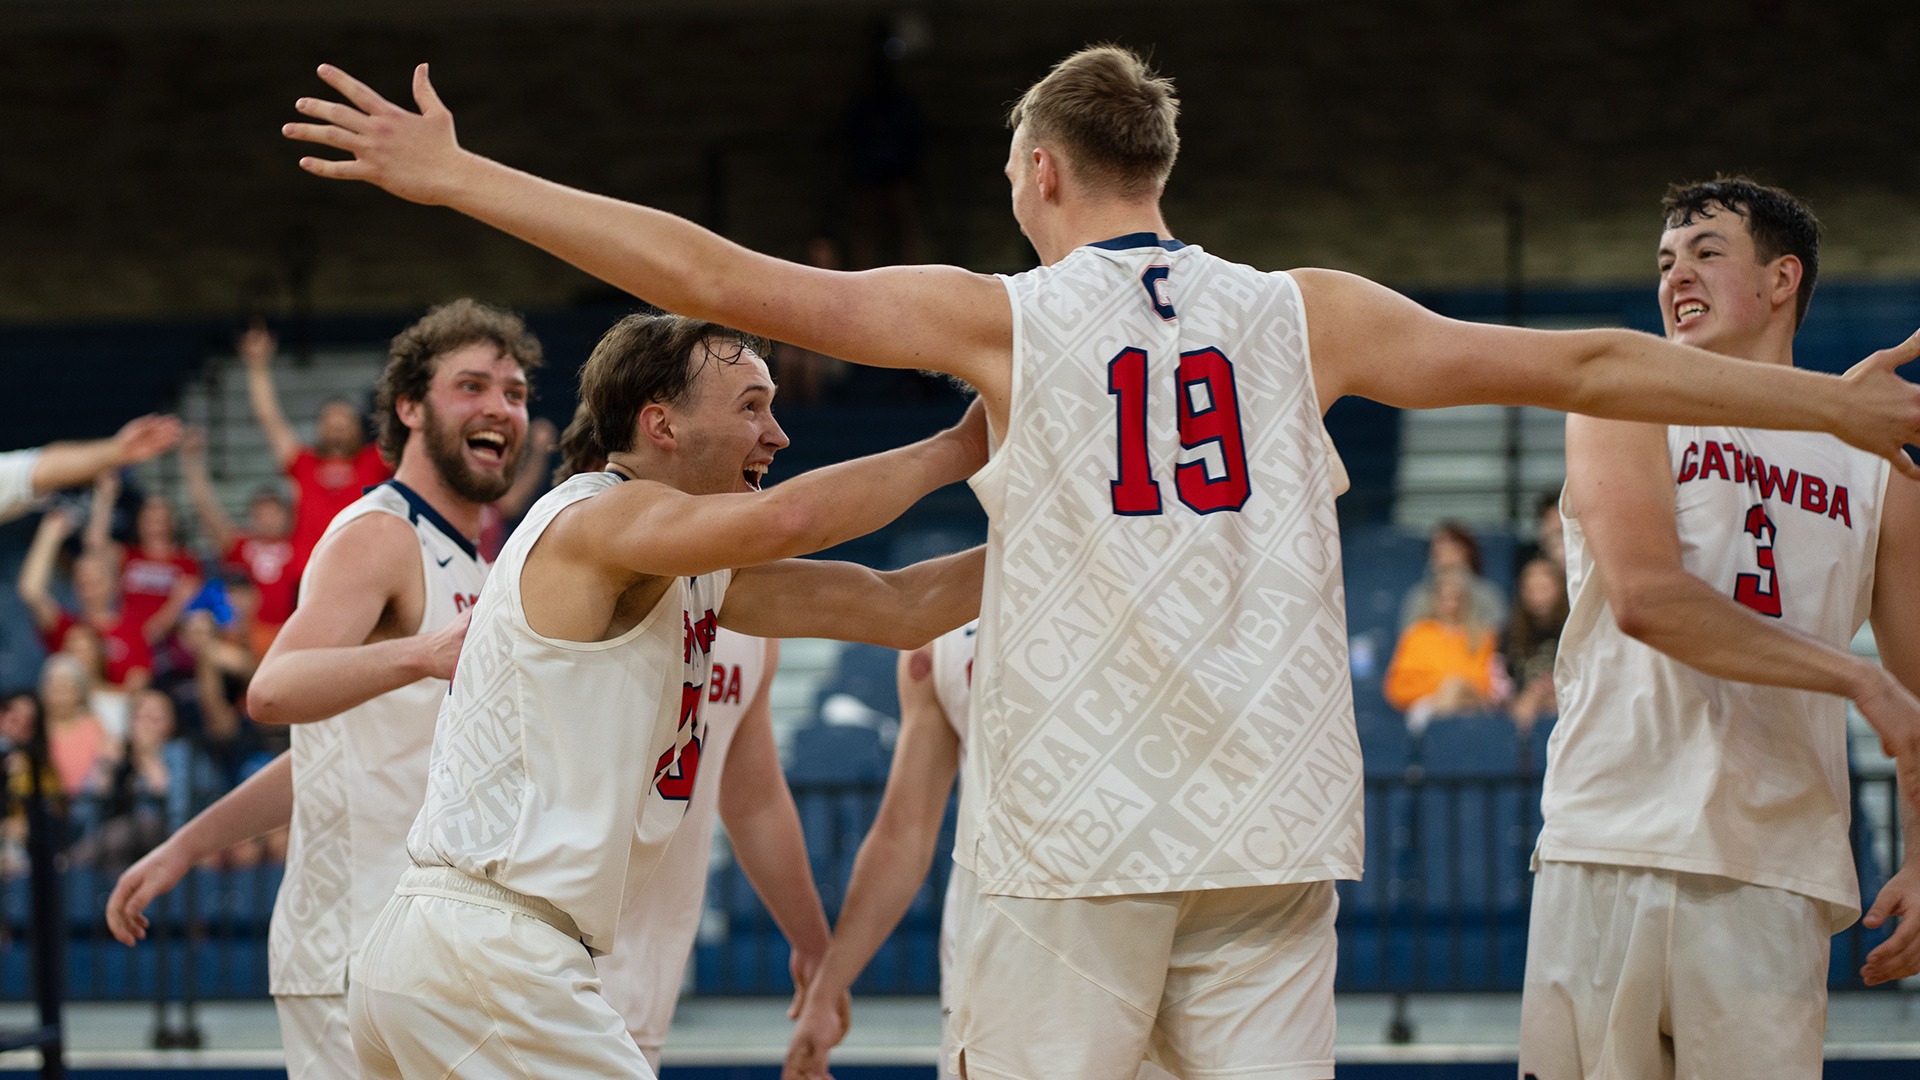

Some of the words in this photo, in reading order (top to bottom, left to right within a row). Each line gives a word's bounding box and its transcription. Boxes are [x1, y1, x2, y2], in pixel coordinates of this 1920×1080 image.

[1140, 264, 1178, 322] C
[1108, 345, 1252, 516] 19
[1677, 441, 1852, 530] CATAWBA
[1075, 533, 1248, 735] CATAWBA
[1734, 504, 1782, 618] 3
[1135, 586, 1308, 778] CATAWBA
[1183, 622, 1348, 828] CATAWBA
